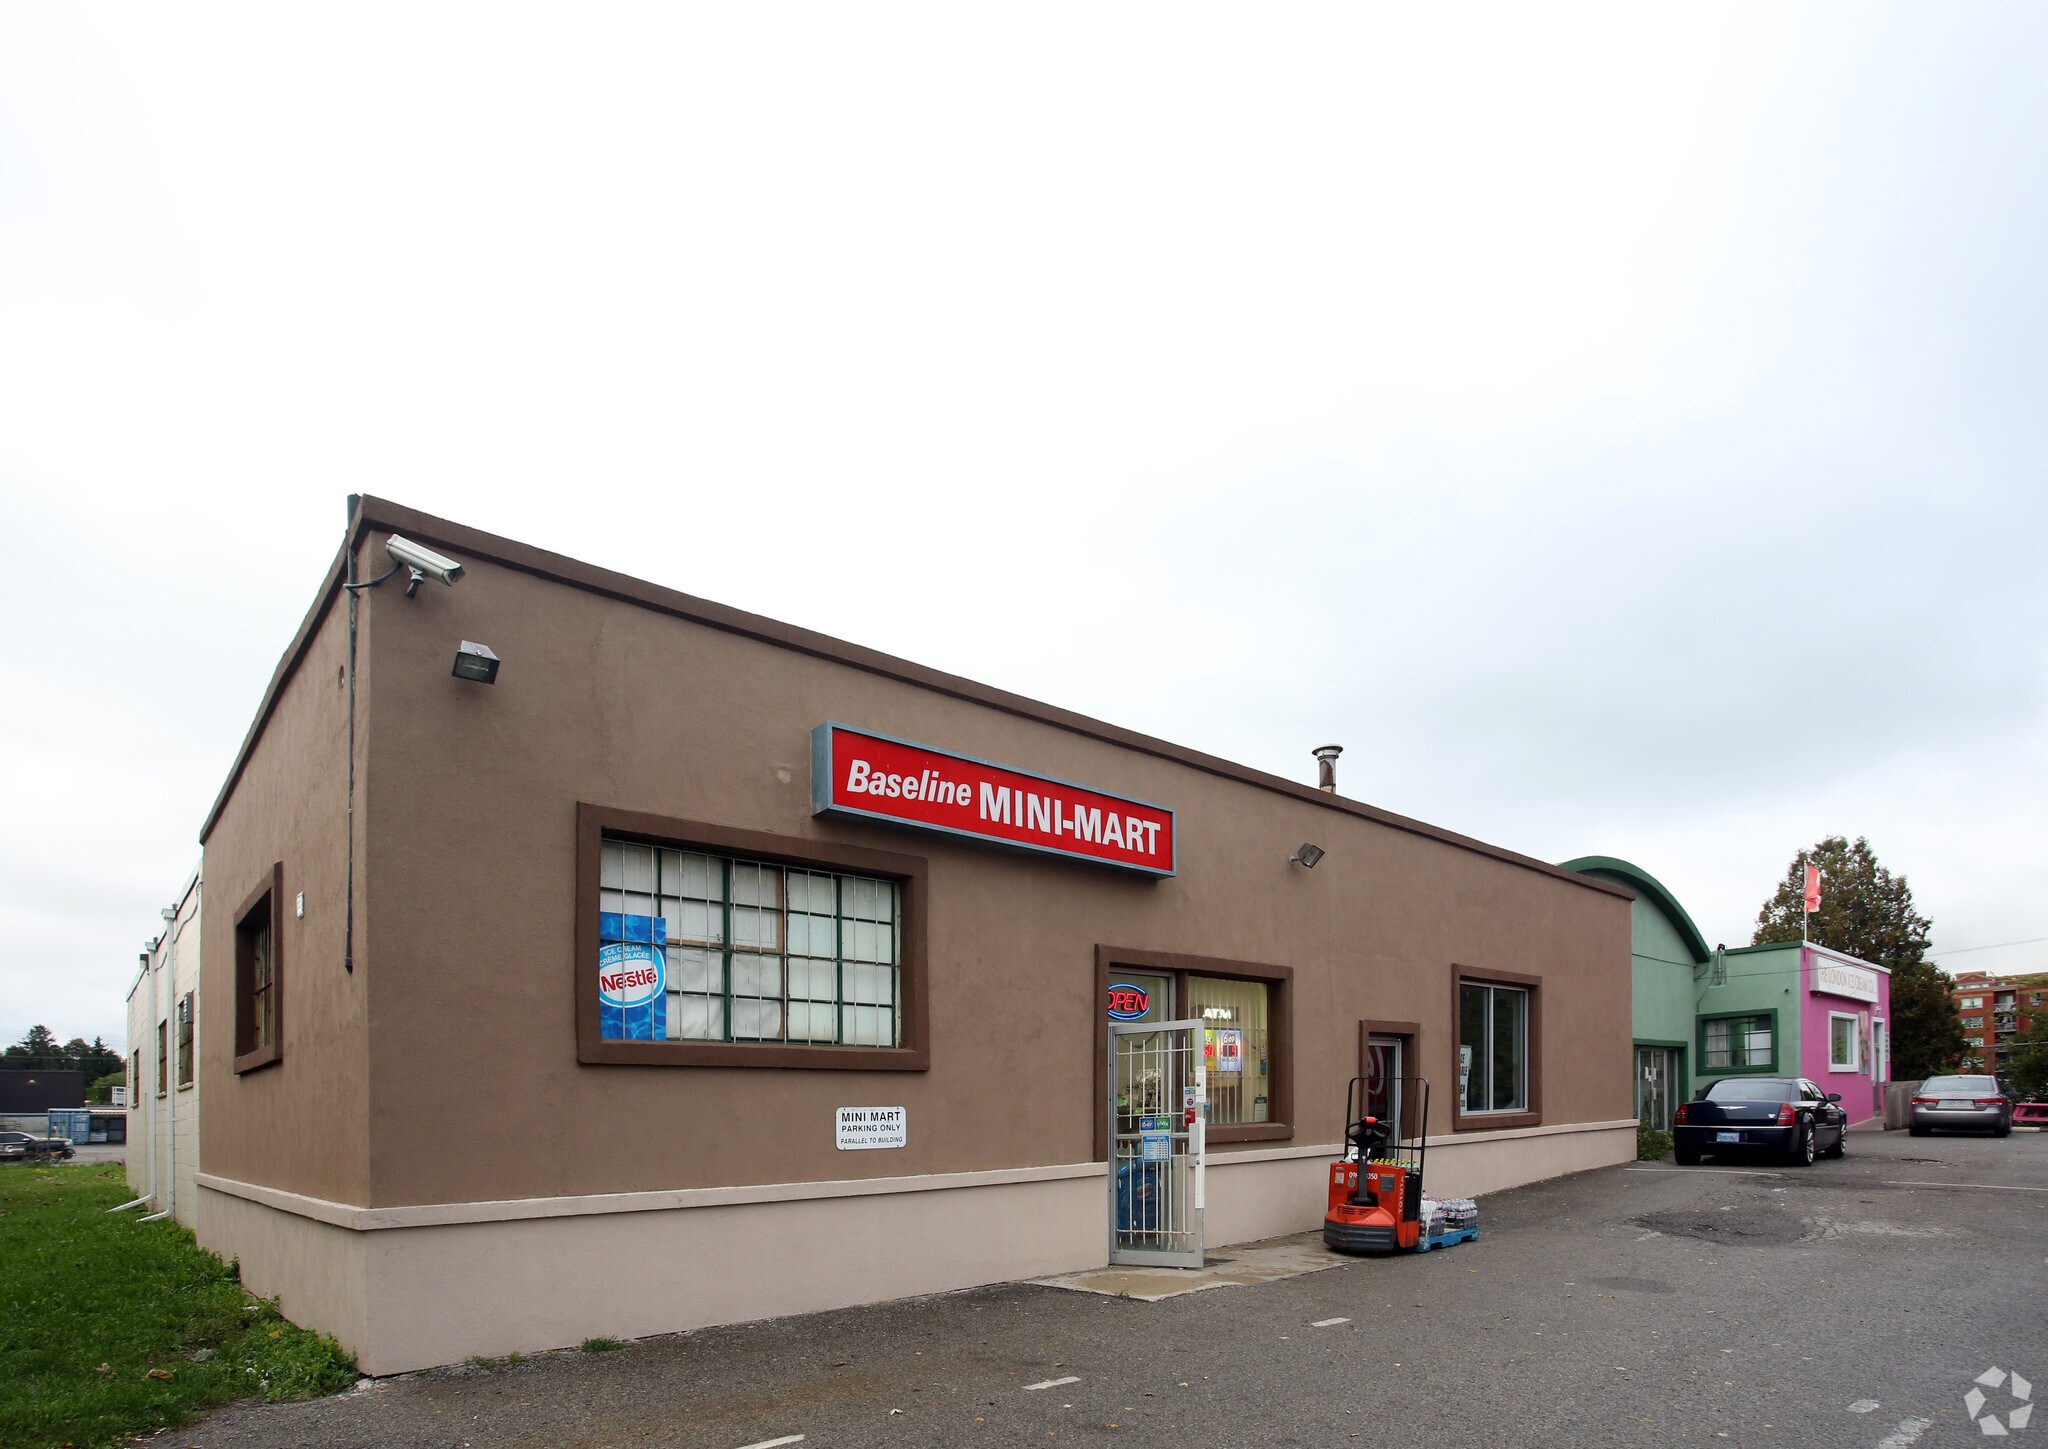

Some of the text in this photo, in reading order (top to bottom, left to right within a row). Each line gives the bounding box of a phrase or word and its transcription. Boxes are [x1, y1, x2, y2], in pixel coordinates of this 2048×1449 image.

[847, 759, 1161, 855] Baseline MINI-MART
[604, 948, 615, 956] ICE
[601, 967, 657, 992] Nestlé
[1202, 1008, 1232, 1019] ATM
[841, 1111, 901, 1122] MINI MART
